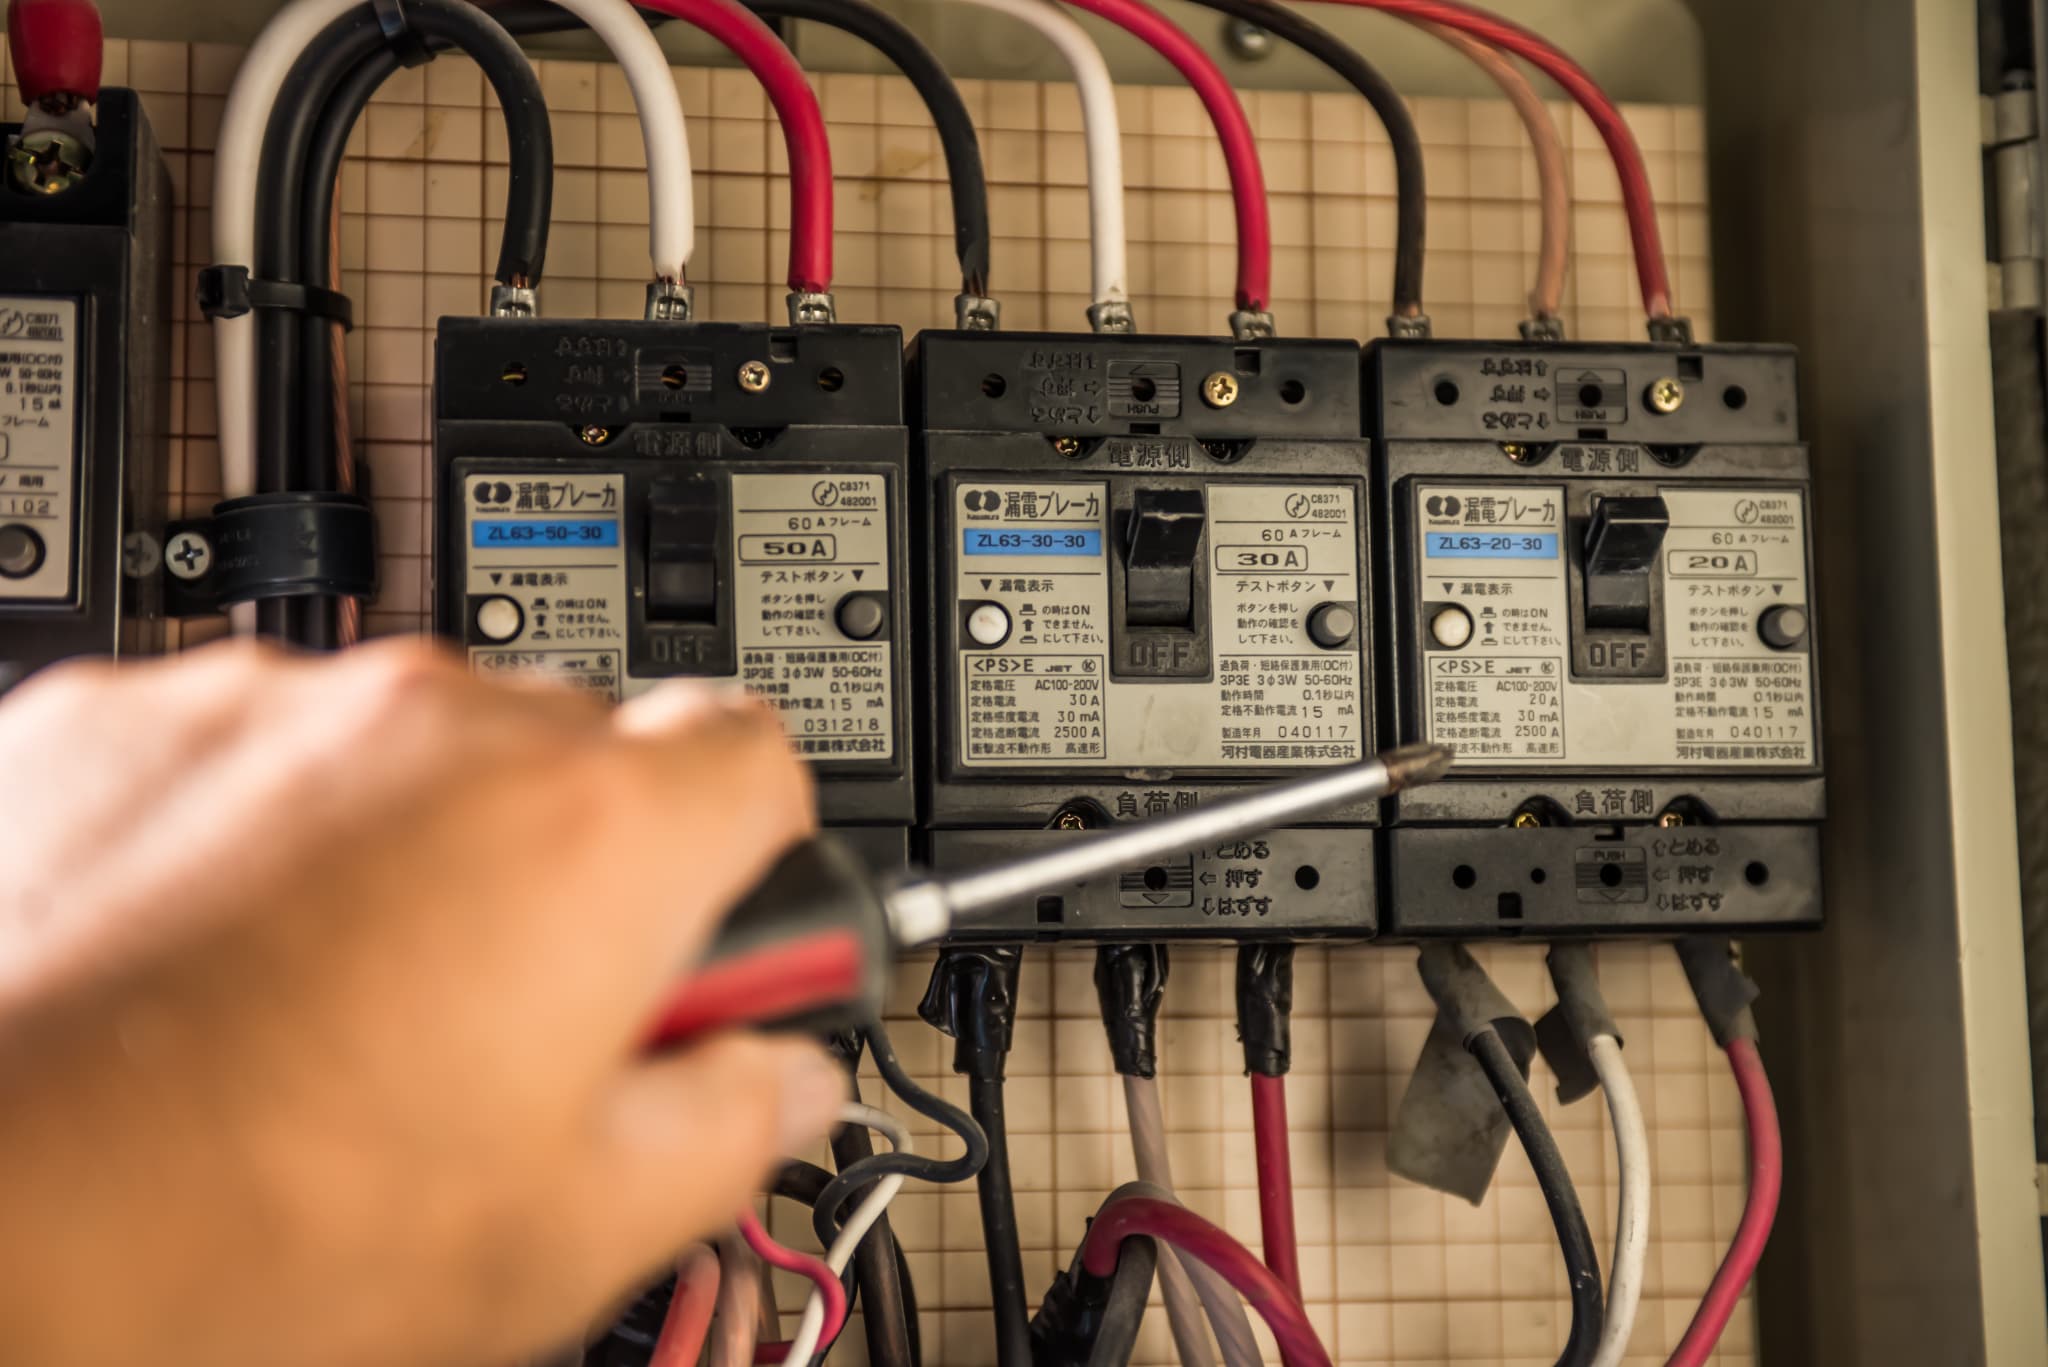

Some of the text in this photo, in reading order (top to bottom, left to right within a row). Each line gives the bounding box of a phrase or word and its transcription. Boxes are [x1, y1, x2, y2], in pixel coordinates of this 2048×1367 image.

[1109, 442, 1191, 468] 電源側
[1560, 448, 1639, 472] 電源側
[516, 482, 616, 509] 漏電ブレーカ
[1004, 491, 1099, 518] 漏電ブレーカ
[1464, 497, 1556, 522] 漏電ブレーカ
[488, 526, 602, 540] ZL63-50-30
[978, 535, 1085, 547] ZL63-30-30
[1440, 537, 1542, 550] ZL63-20-30
[510, 573, 567, 586] 漏電表示
[761, 571, 844, 583] テストボタン
[1000, 580, 1054, 592] 漏電表示
[1236, 580, 1316, 592] テストボタン
[1461, 583, 1512, 594] 漏電表示
[1688, 584, 1765, 596] テストボタン
[1237, 603, 1298, 613] ボタンを押し
[1690, 607, 1748, 616] ボタンを押し
[1044, 620, 1094, 630] できません。
[1237, 618, 1298, 628] 動作の確認を
[1690, 622, 1748, 632] 動作の確認を
[1044, 633, 1103, 644] にして下さい。
[1239, 634, 1293, 644] して下さい。
[1504, 636, 1562, 646] にして下さい。
[654, 636, 712, 662] OFF
[1131, 642, 1190, 667] OFF
[1590, 642, 1646, 667] OFF
[744, 668, 774, 678] 3P3E
[832, 666, 882, 678] 50-60Hz
[970, 680, 1099, 691] 定格電圧 AC100-200V
[1220, 674, 1250, 686] 3P3E
[1304, 674, 1352, 686] 50-60Hz
[1434, 681, 1558, 692] 定格電圧 AC100-200V
[1221, 690, 1264, 700] 動作時間
[867, 698, 884, 708] mA
[971, 696, 1016, 707] 定格電流
[1435, 696, 1478, 708] 定格電流
[1221, 704, 1298, 716] 定格不動作電流
[1338, 704, 1354, 715] mA
[971, 712, 1039, 722] 定格感度電流
[1436, 712, 1502, 722] 定格感度電流
[804, 718, 878, 732] 031218
[1222, 726, 1348, 738] 製造年月 040117
[1730, 726, 1798, 738] 040117
[1066, 742, 1100, 754] 高速形
[1222, 745, 1356, 759] 河村電器産業株式会社
[1116, 791, 1198, 817] 負荷側
[1575, 790, 1653, 814] 負荷側
[1226, 868, 1262, 888] 押す
[1218, 897, 1272, 916] はずす
